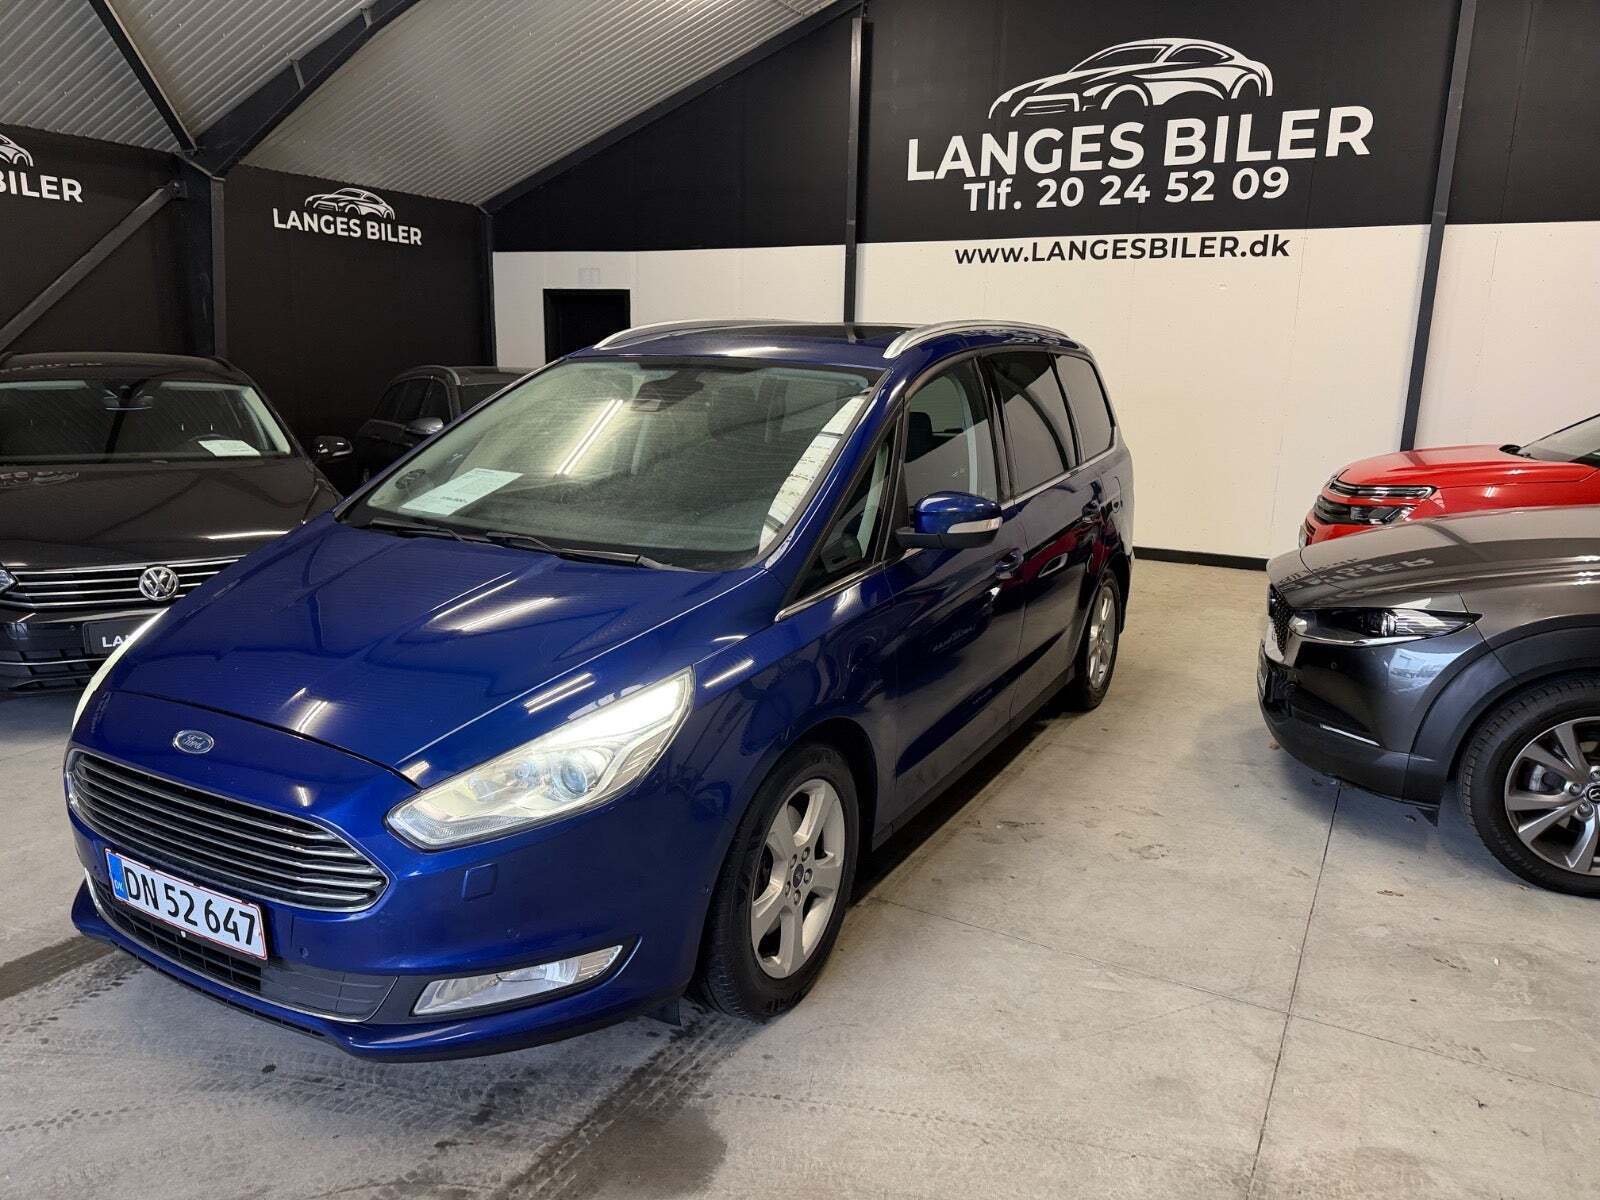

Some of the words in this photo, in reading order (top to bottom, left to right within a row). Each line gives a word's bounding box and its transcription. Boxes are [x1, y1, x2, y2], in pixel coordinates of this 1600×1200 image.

[907, 121, 1145, 182] LANGES
[1163, 105, 1374, 167] BILER
[964, 178, 1022, 211] Tlf.
[1036, 177, 1084, 208] 20
[1099, 174, 1151, 205] 24
[1164, 170, 1215, 203] 52
[1232, 166, 1289, 200] 09
[272, 207, 362, 238] LANGES
[366, 220, 423, 246] BILER
[955, 233, 1291, 265] www.LANGESBILER.dk
[102, 634, 128, 648] LA
[123, 866, 160, 911] DN
[163, 882, 198, 927] 52
[203, 898, 256, 946] 647
